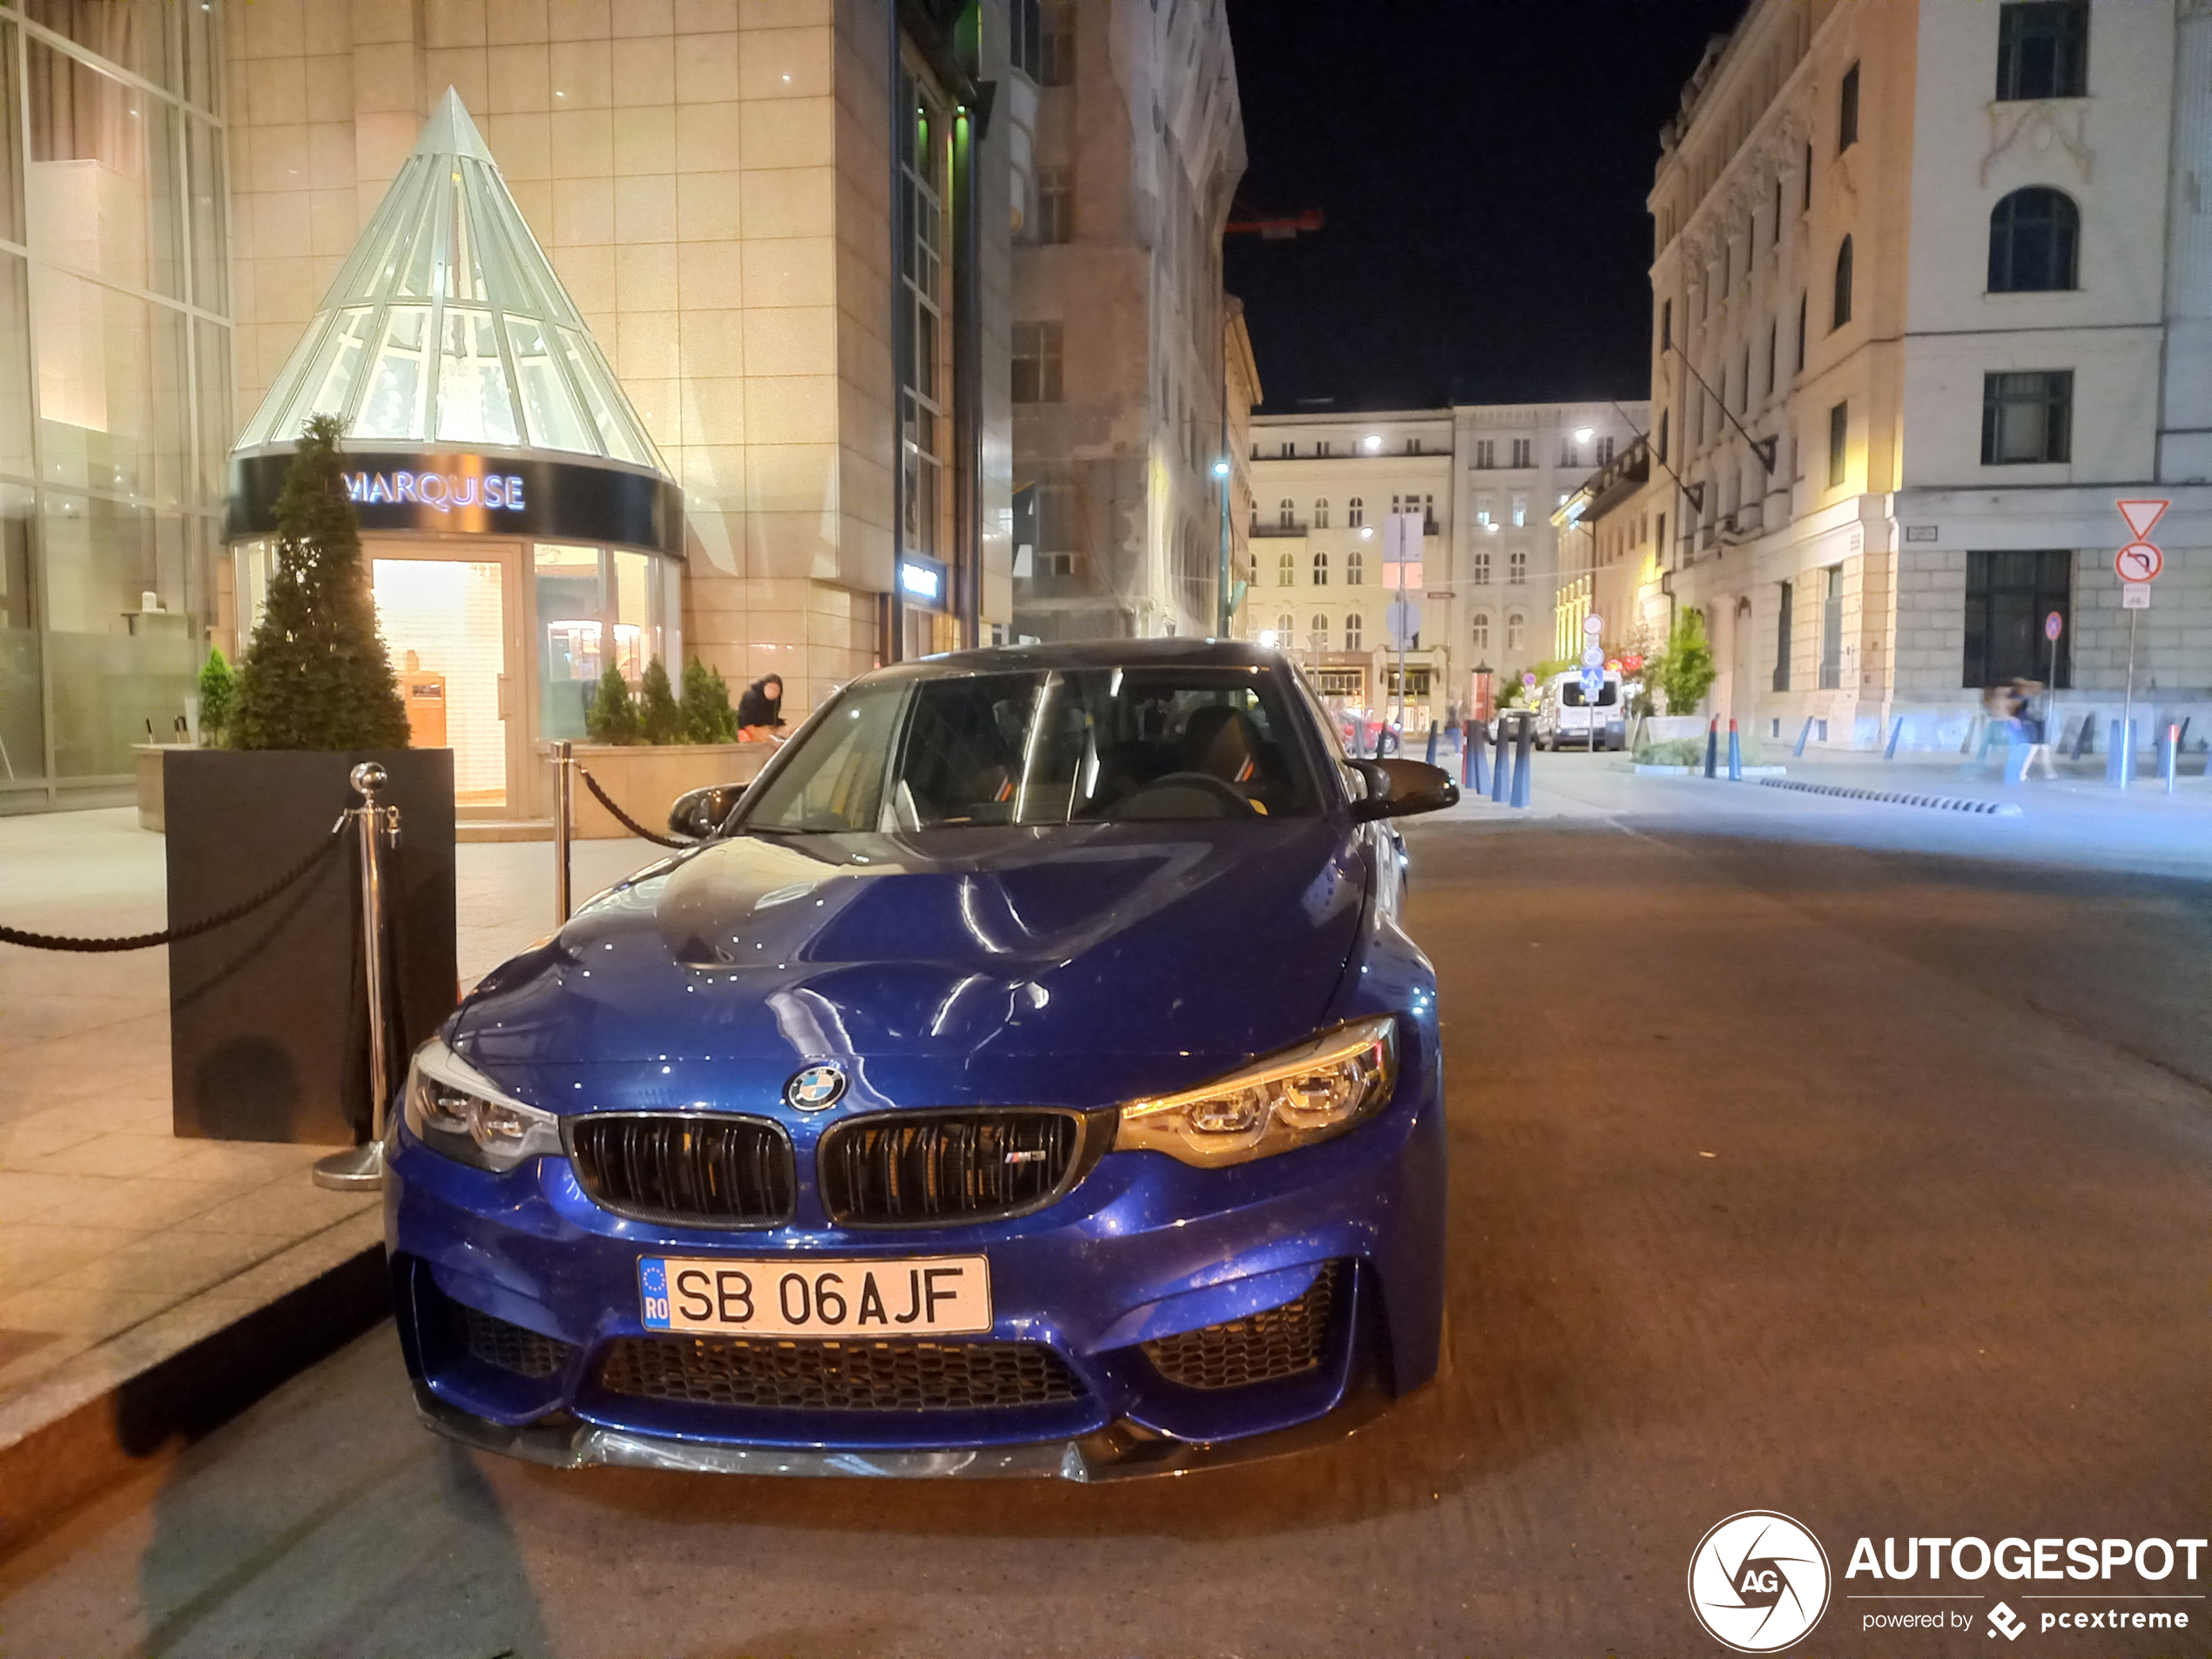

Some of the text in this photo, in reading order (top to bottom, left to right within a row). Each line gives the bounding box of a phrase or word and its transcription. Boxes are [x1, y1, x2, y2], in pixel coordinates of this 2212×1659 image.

[340, 470, 525, 513] MARQUISE
[645, 1296, 668, 1319] RO
[676, 1269, 755, 1323] SB
